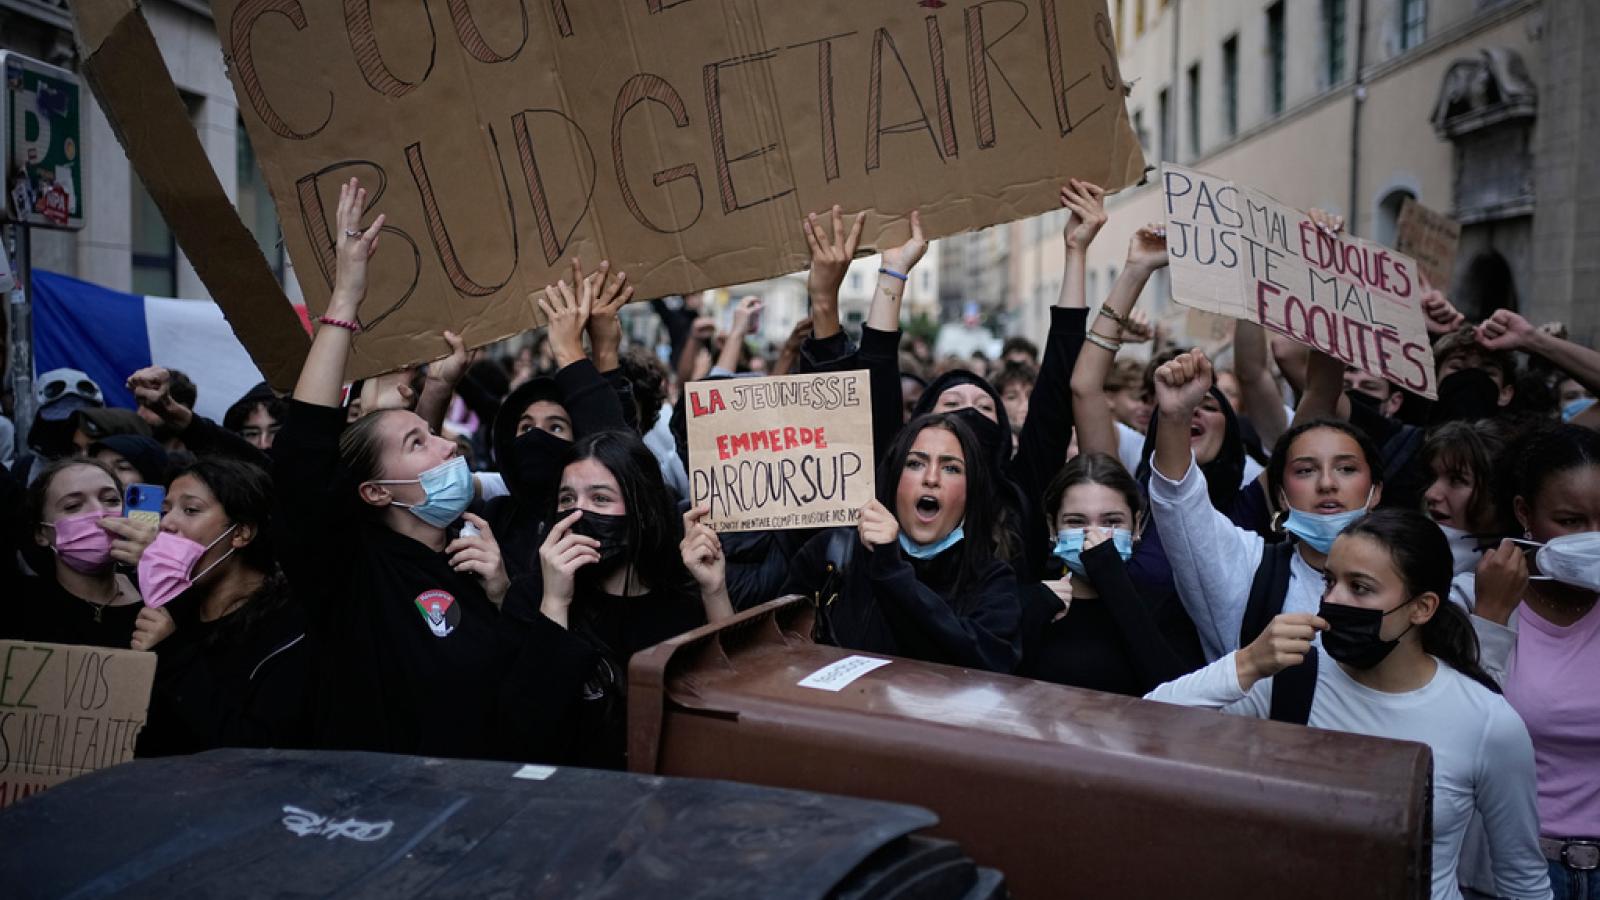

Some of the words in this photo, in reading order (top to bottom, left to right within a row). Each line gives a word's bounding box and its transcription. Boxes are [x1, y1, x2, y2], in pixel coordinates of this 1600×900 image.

[1163, 172, 1244, 228] PAS
[1246, 199, 1298, 256] MAL
[1170, 220, 1290, 291] JUSTE
[1308, 268, 1398, 330] MAL
[690, 388, 727, 418] LA
[731, 375, 860, 411] JEUNESSE
[715, 426, 828, 461] EMMERDE
[692, 451, 862, 519] PARCOURSUP
[771, 513, 800, 527] COMPTE
[63, 650, 114, 711] VOS
